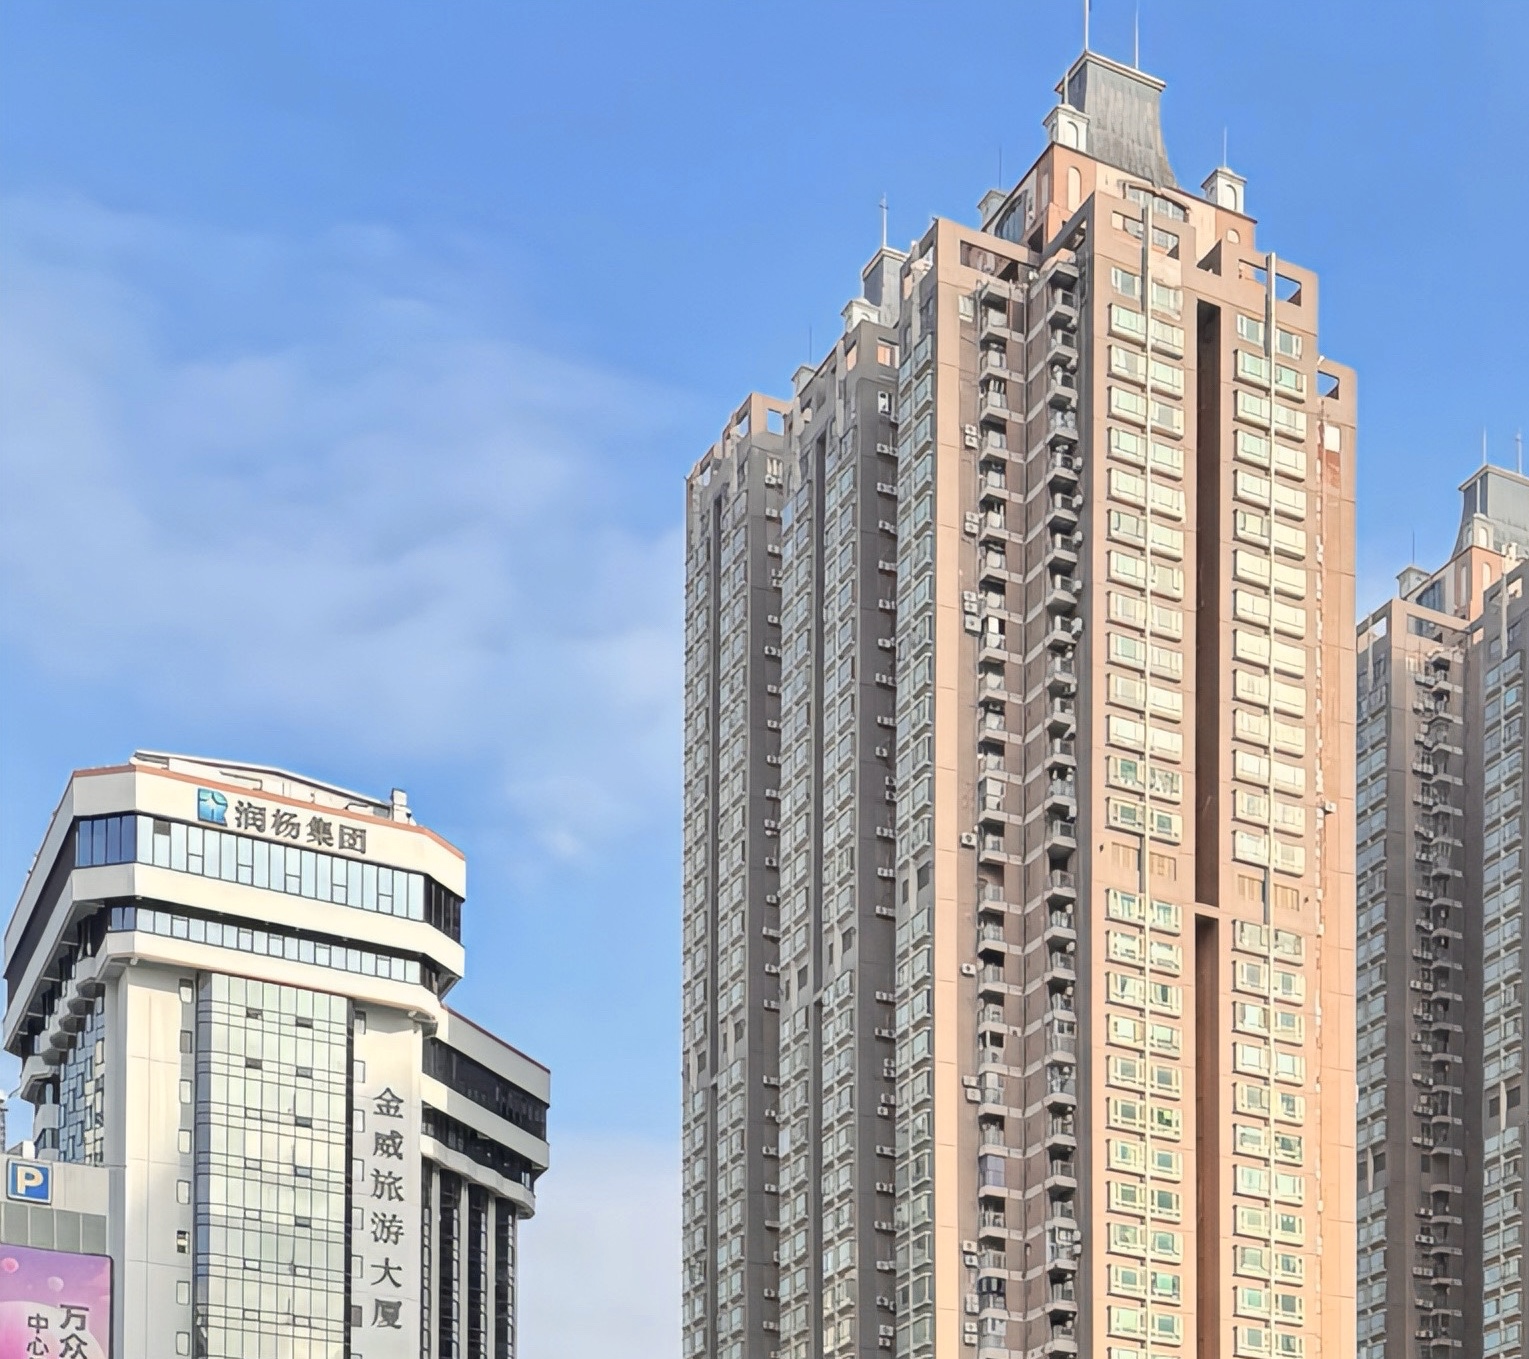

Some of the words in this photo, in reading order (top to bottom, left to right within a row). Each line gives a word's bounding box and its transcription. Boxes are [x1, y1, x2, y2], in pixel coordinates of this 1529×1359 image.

[17, 1165, 44, 1195] P
[370, 1087, 405, 1329] 金威旅游大厦
